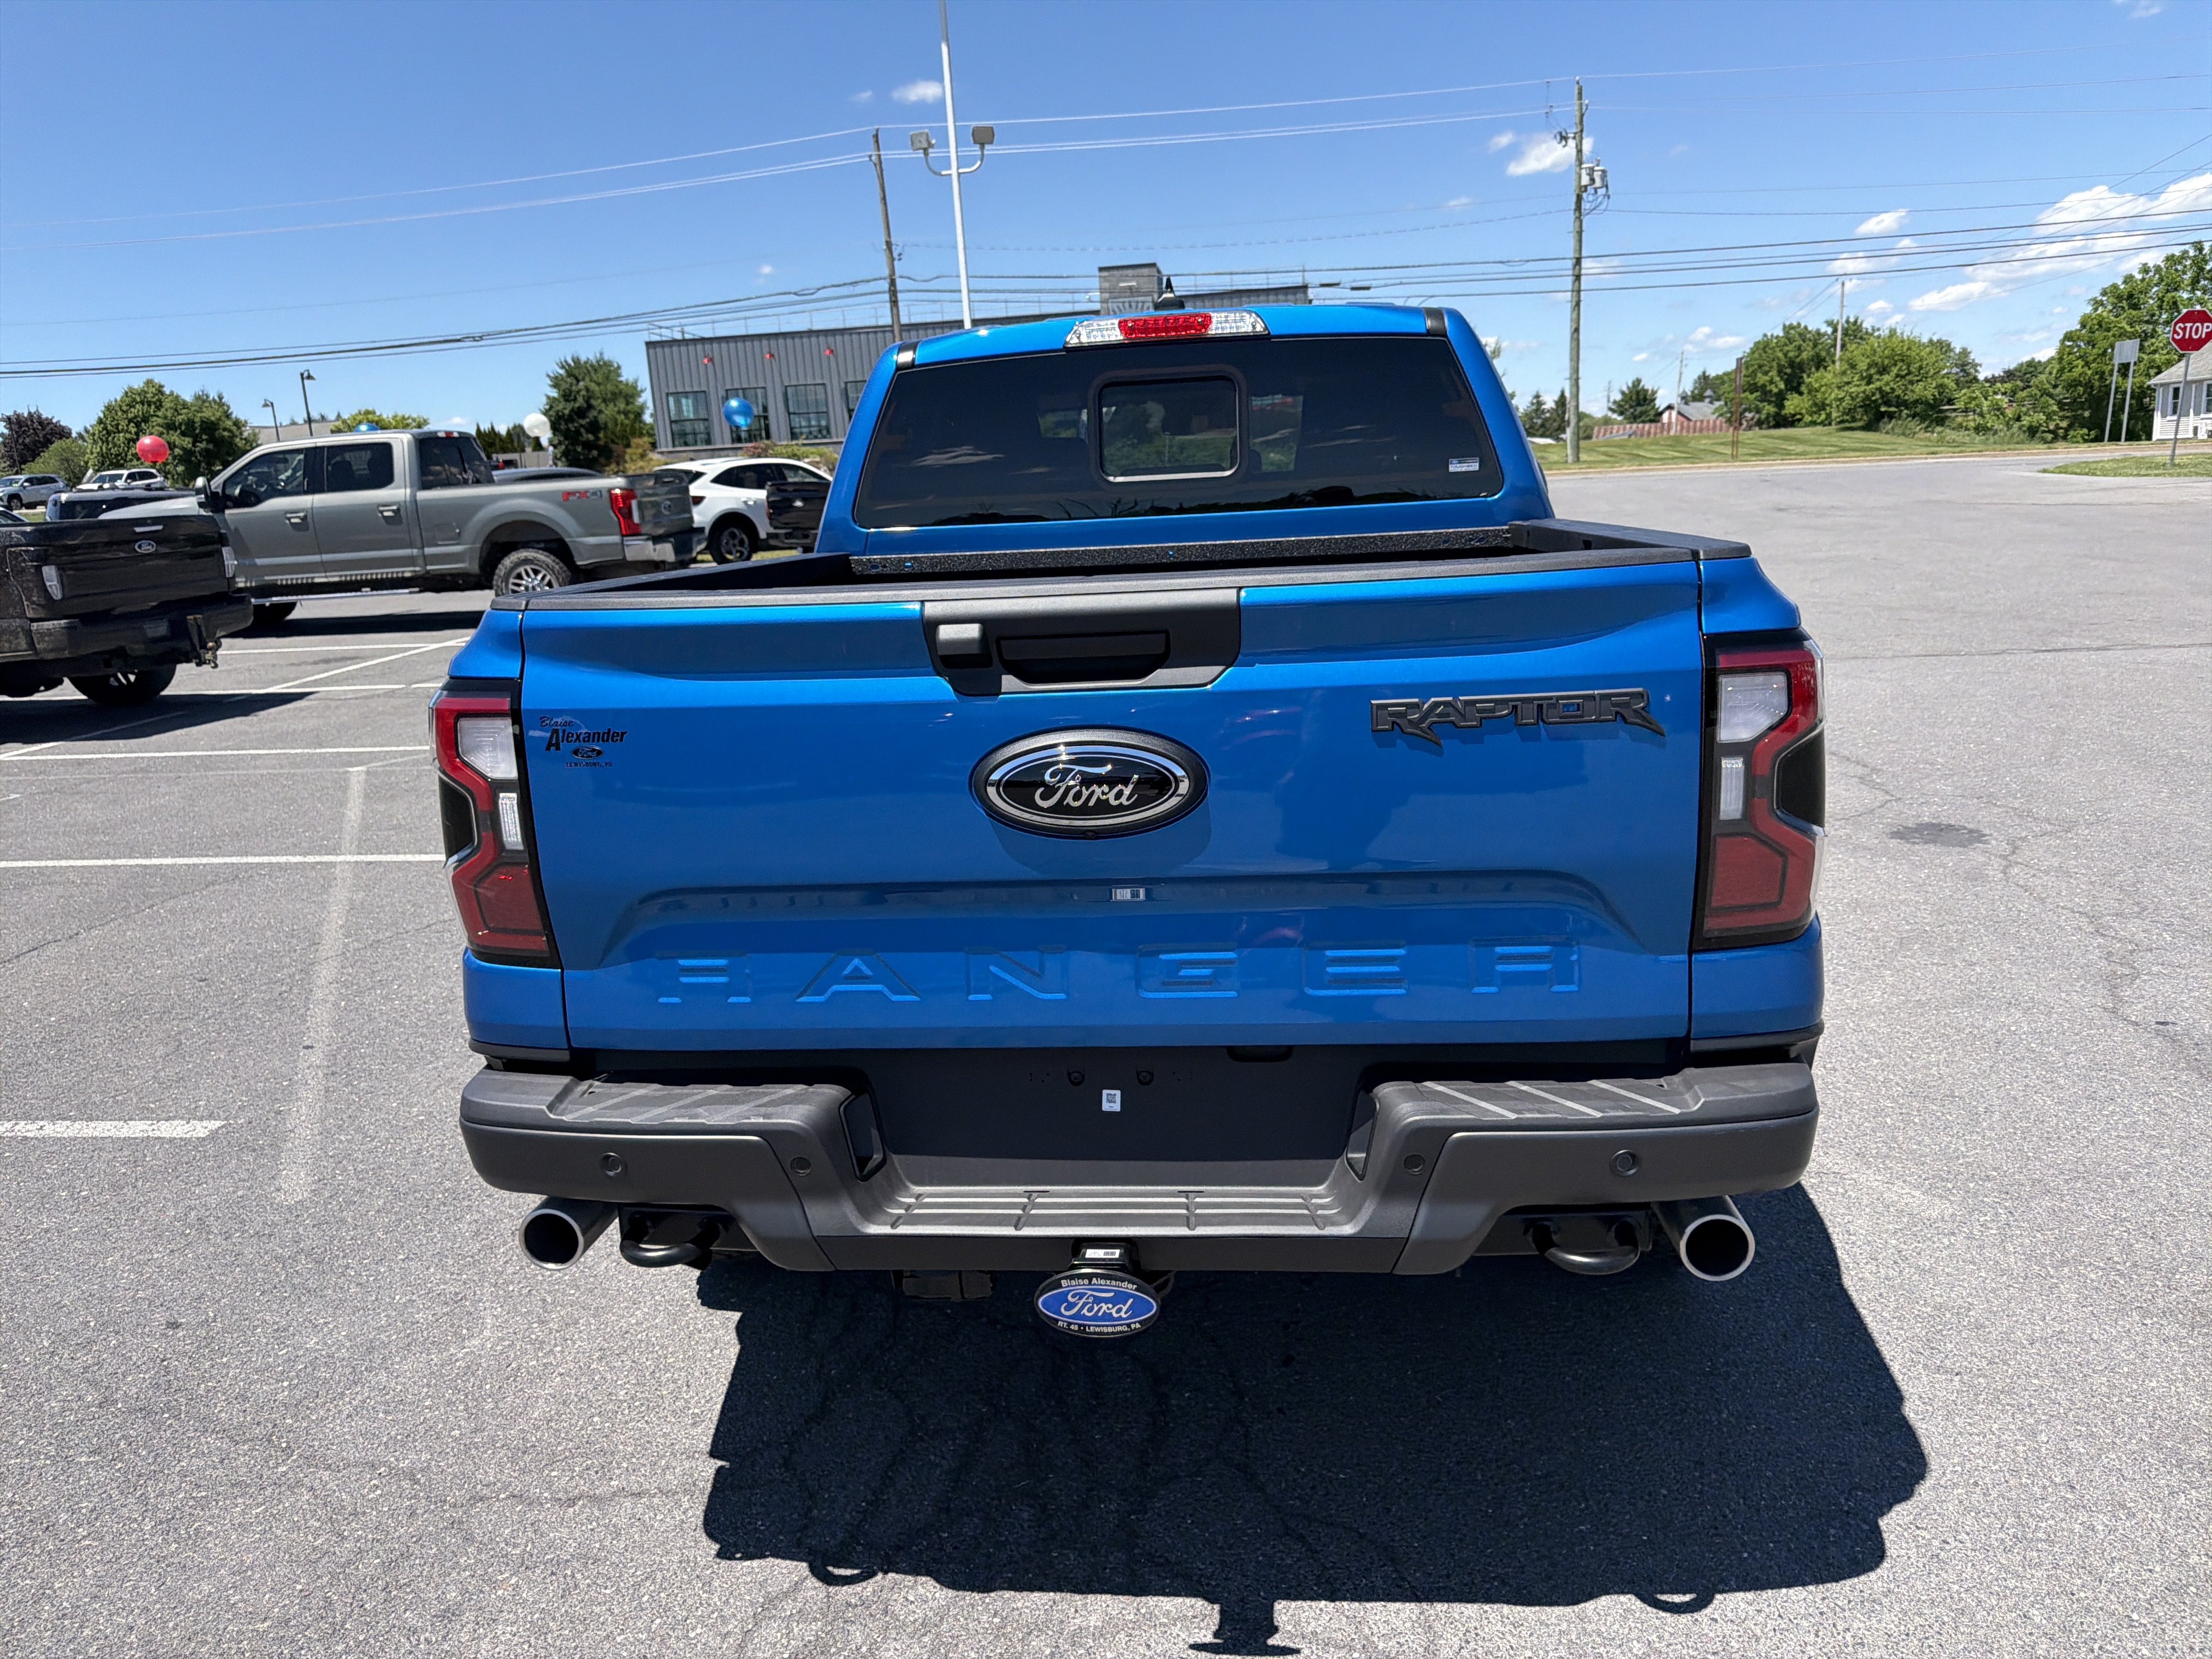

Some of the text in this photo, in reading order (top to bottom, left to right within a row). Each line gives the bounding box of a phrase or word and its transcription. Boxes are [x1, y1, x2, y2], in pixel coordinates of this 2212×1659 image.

[2174, 322, 2212, 339] STOP
[539, 715, 574, 727] Blaise
[1370, 688, 1666, 747] RAPTOR
[545, 728, 628, 752] Alexander
[1035, 764, 1139, 808] Ford
[656, 936, 1581, 1004] RANGER
[1060, 1277, 1137, 1290] Blaise Alexander
[1060, 1289, 1134, 1318] Ford
[1057, 1321, 1069, 1329] RT.
[1131, 1322, 1142, 1330] PA
